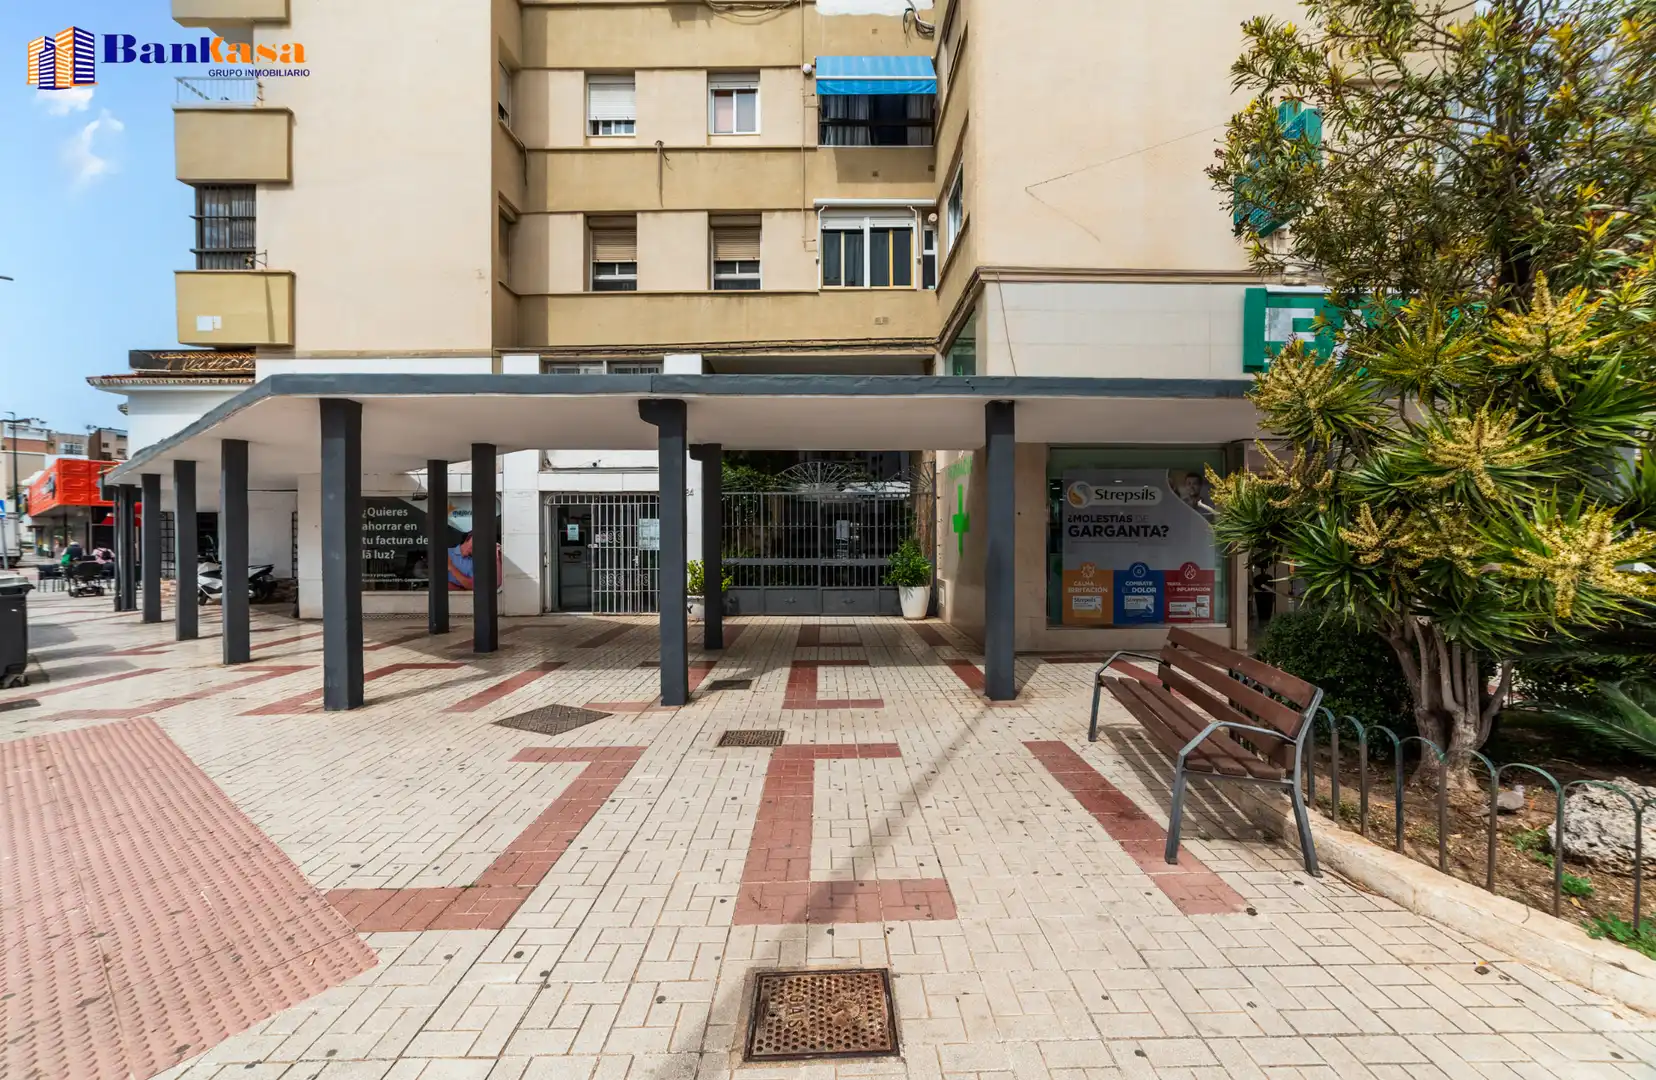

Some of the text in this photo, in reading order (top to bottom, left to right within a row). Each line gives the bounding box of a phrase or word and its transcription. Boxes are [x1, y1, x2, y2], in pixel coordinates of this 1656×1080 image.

[1094, 488, 1156, 503] Strepsils
[362, 507, 408, 518] ¿Quieres
[1067, 514, 1133, 523] ¿MOLESTIAS
[362, 521, 418, 531] ahorrar en
[1068, 525, 1170, 538] GARGANTA?
[362, 535, 429, 545] tu factura de
[374, 549, 395, 559] luz?
